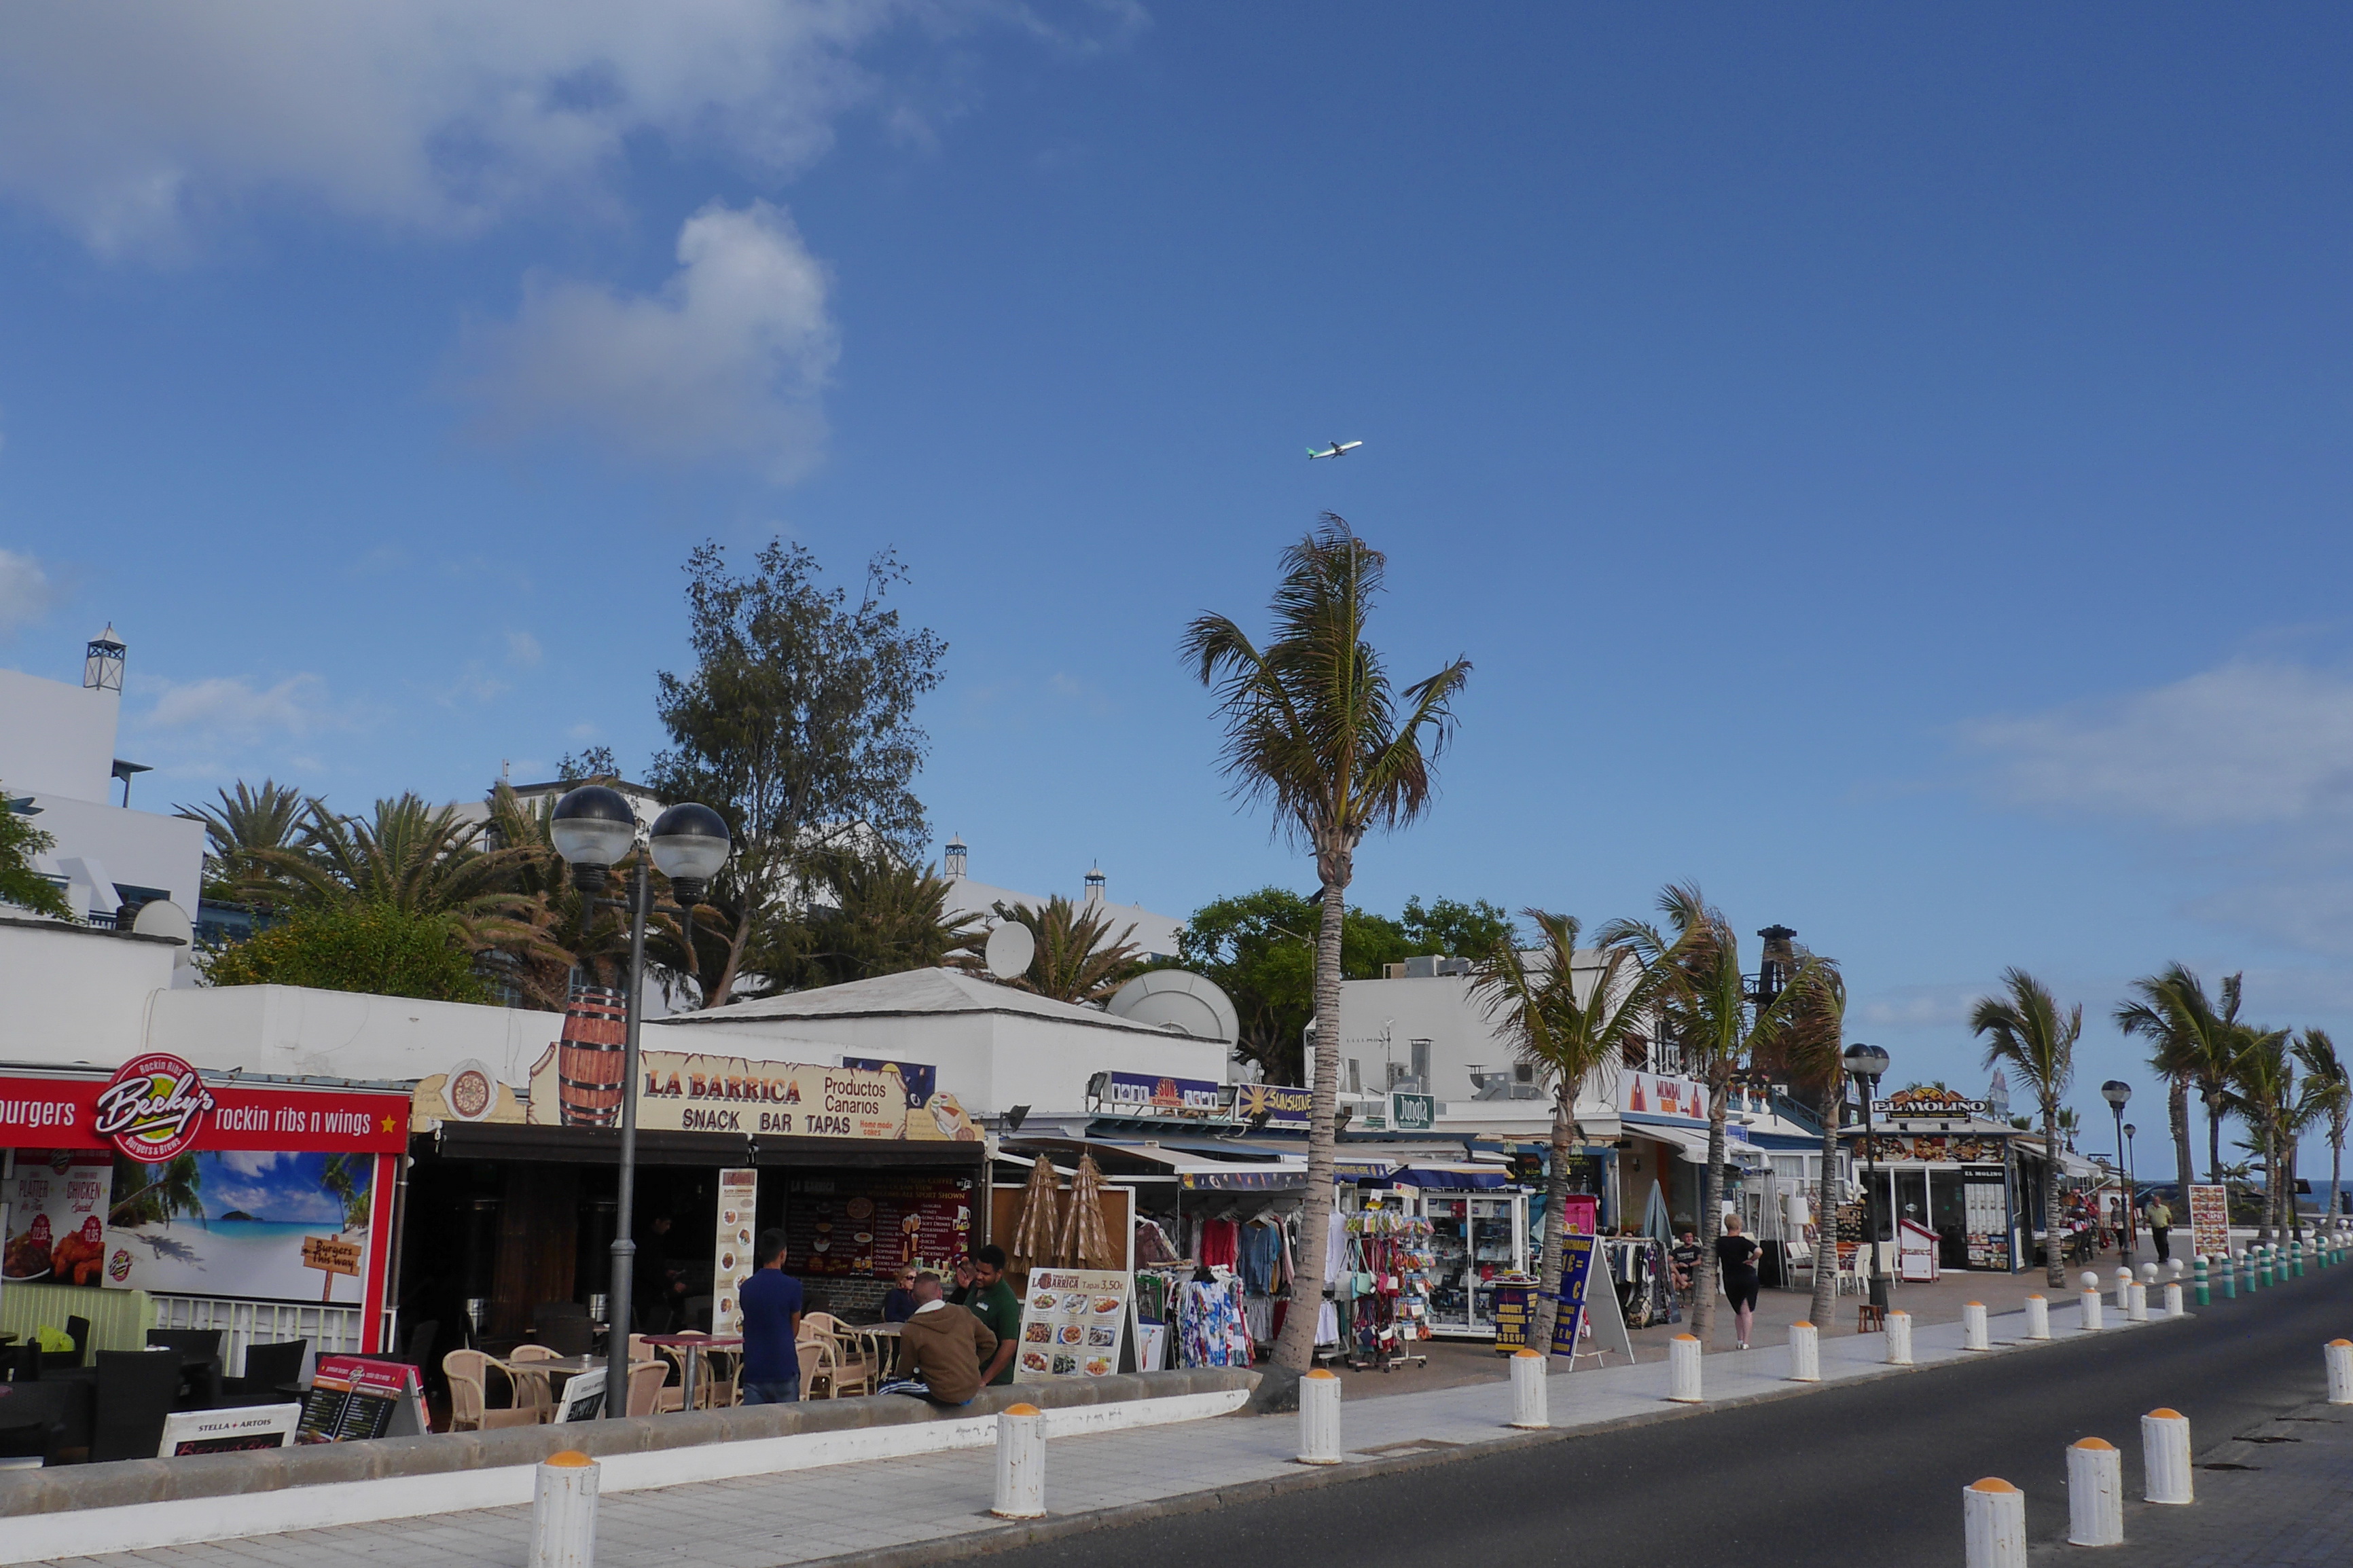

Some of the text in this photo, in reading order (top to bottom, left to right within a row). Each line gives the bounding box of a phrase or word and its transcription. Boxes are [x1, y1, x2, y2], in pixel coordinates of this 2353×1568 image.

[139, 1059, 183, 1076] Rockin Ribs
[643, 1069, 802, 1105] LA BARRICA
[825, 1076, 886, 1097] Productos
[1160, 1078, 1175, 1098] SUN
[1657, 1080, 1681, 1100] MUMBAI
[95, 1072, 215, 1135] Becky's
[825, 1095, 880, 1114] Canarios
[1152, 1099, 1181, 1107] ELECTRONICS
[1270, 1091, 1312, 1112] SUNSHINE
[1399, 1095, 1428, 1127] Jungla
[1873, 1101, 1986, 1112] EL MOLINO
[215, 1106, 370, 1136] rockin ribs n wings
[682, 1108, 850, 1135] SNACK BAR TAPAS
[125, 1136, 152, 1154] Burgers
[160, 1138, 181, 1154] Brews
[67, 1182, 101, 1199] CHICKEN
[937, 1191, 965, 1200] SHOWN
[317, 1241, 353, 1258] Burgers
[313, 1250, 354, 1273] This way
[1047, 1278, 1079, 1289] BARRICA
[1082, 1281, 1100, 1290] Tapas
[198, 1419, 272, 1432] STELLA ARTOIS
